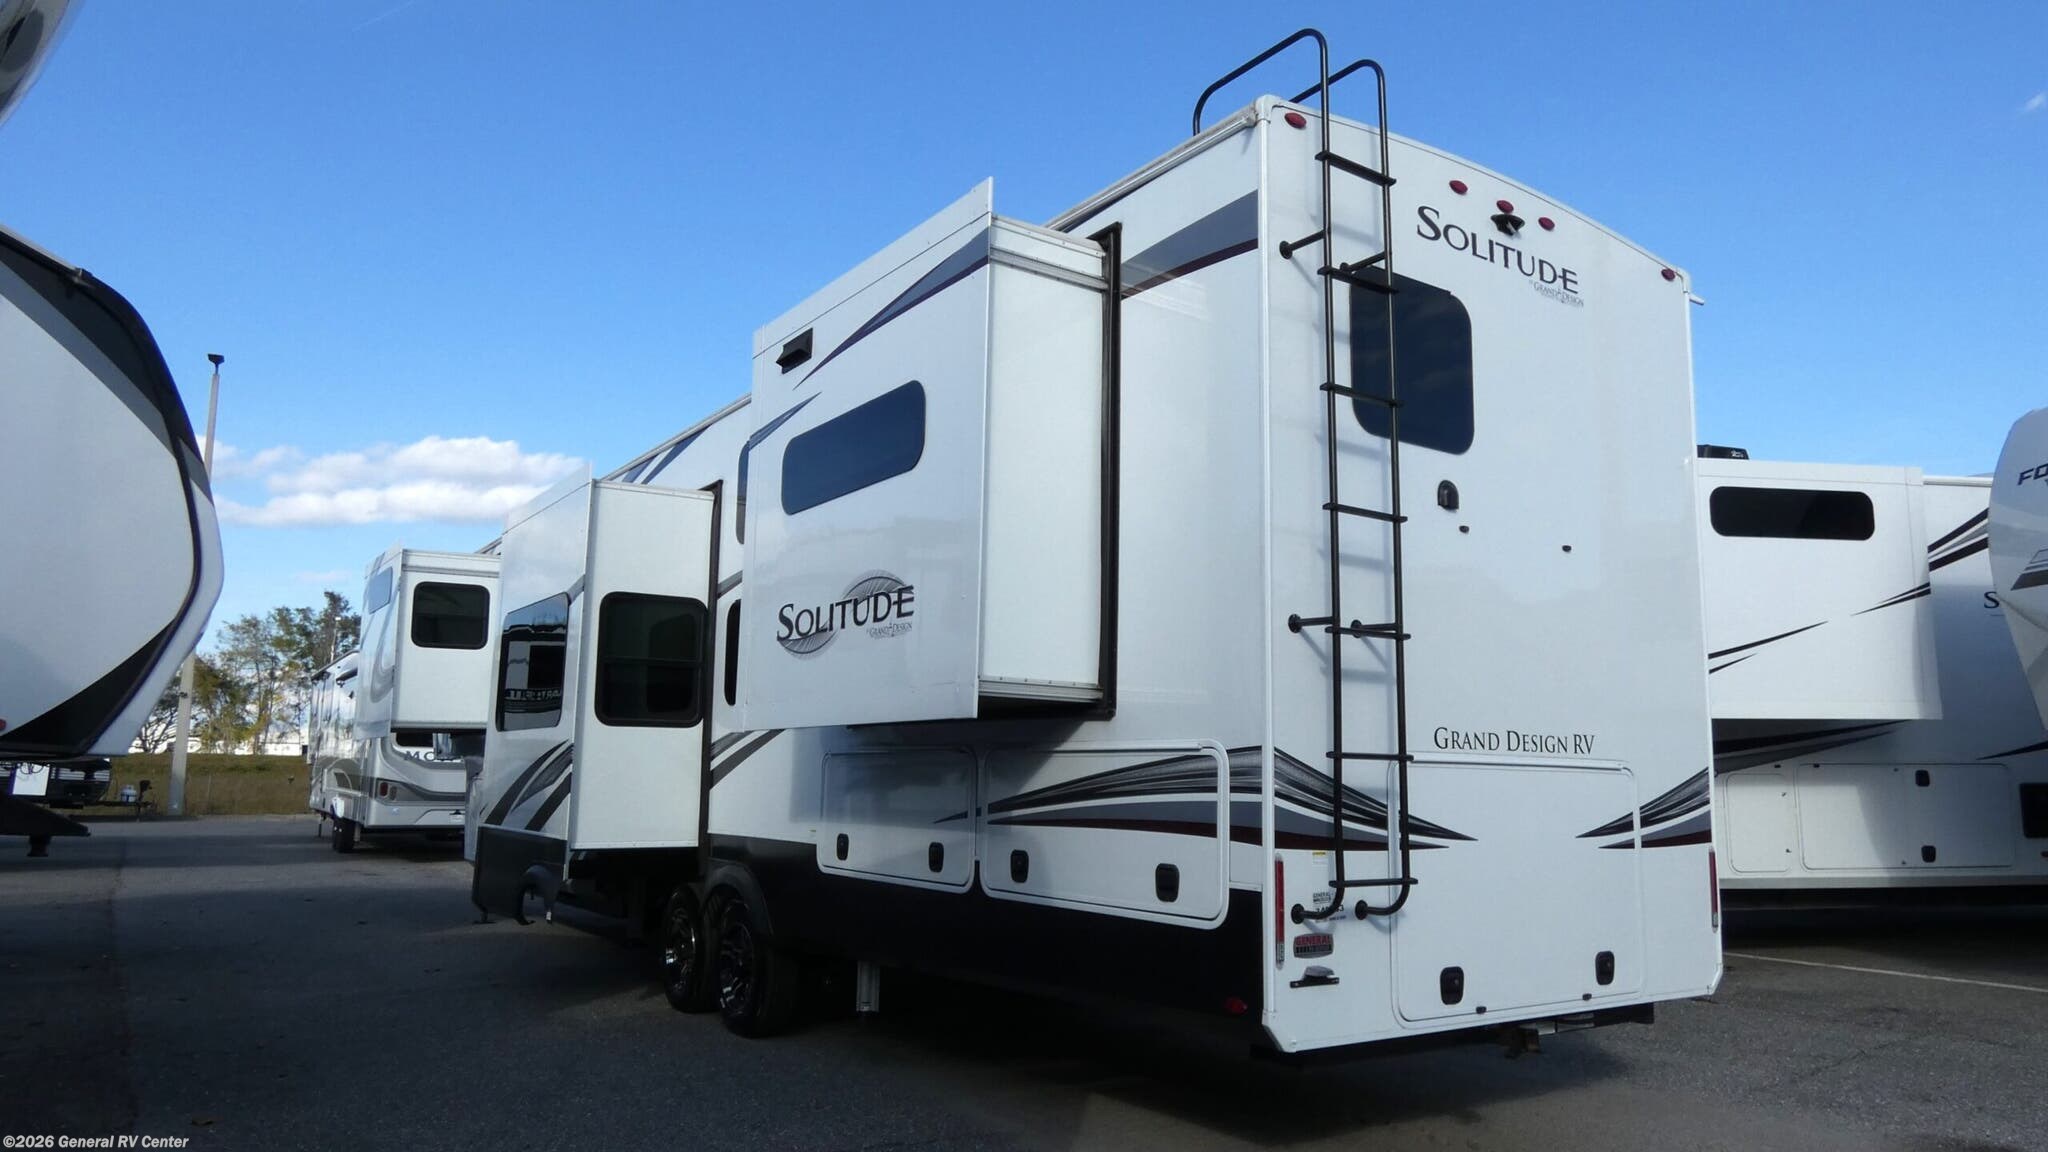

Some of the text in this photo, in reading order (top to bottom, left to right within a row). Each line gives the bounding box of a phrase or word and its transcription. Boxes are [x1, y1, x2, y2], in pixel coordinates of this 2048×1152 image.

[1416, 205, 1579, 295] SOLITUDE
[776, 585, 915, 642] SOLITUDE
[1433, 726, 1595, 755] GRAND DESIGN RV
